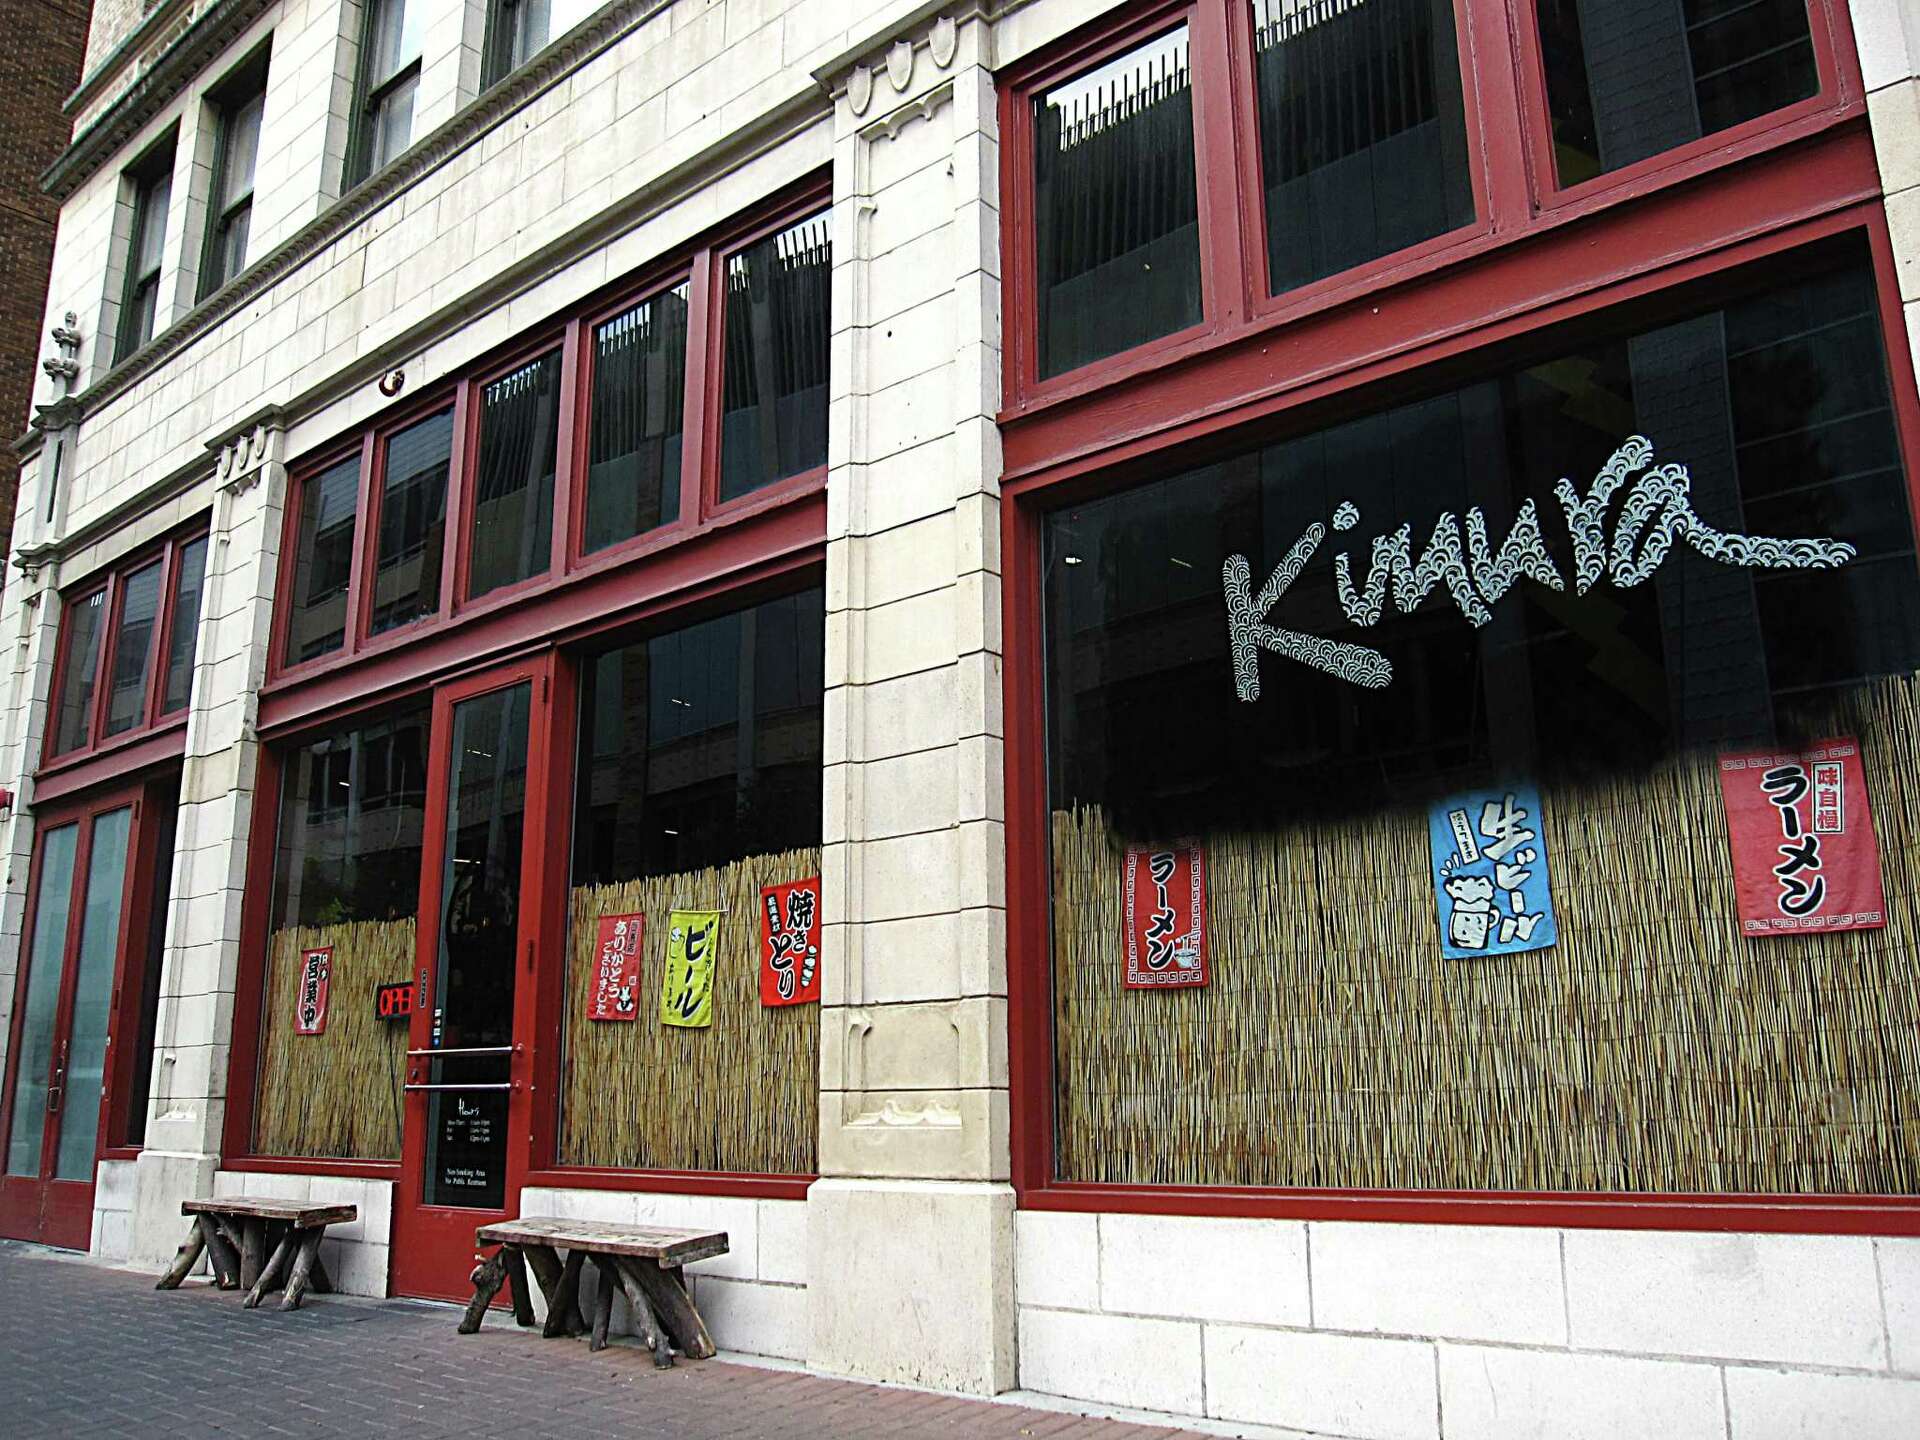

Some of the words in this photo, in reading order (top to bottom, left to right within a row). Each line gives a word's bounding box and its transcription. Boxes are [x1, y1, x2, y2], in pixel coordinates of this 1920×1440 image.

[1761, 765, 1826, 917] ラーメン
[1816, 767, 1839, 830] 味自慢
[1145, 852, 1176, 969] ラーメン
[1480, 793, 1545, 944] 生ビール
[608, 920, 628, 999] ありがとう
[674, 920, 714, 1021] ビール
